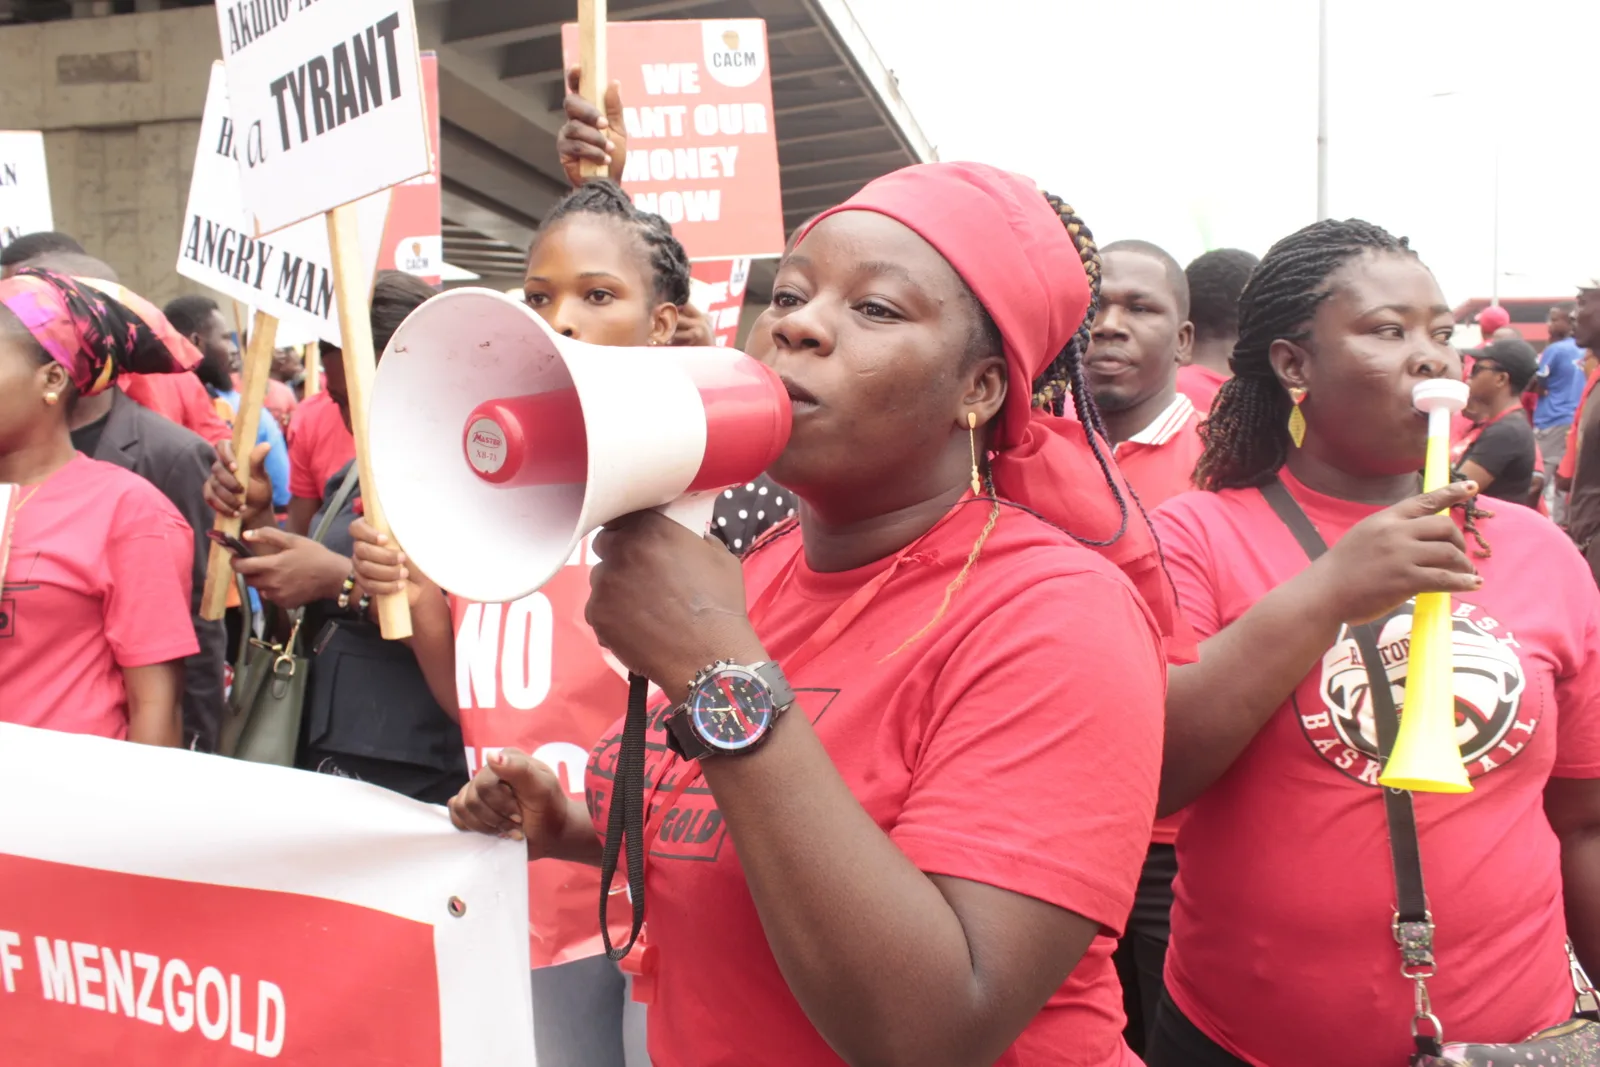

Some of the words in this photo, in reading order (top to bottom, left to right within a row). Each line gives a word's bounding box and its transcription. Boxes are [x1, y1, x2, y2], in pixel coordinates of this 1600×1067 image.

[712, 52, 757, 68] CACM
[247, 119, 266, 168] a
[269, 11, 402, 152] TYRANT
[641, 63, 700, 95] WE
[623, 104, 687, 138] ANT
[694, 103, 767, 136] OUR
[622, 146, 739, 182] MONEY
[633, 190, 721, 223] NOW
[184, 214, 273, 290] ANGRY
[274, 250, 334, 320] MAN
[455, 591, 553, 710] NO
[0, 929, 23, 993] F
[34, 936, 286, 1058] MENZGOLD
